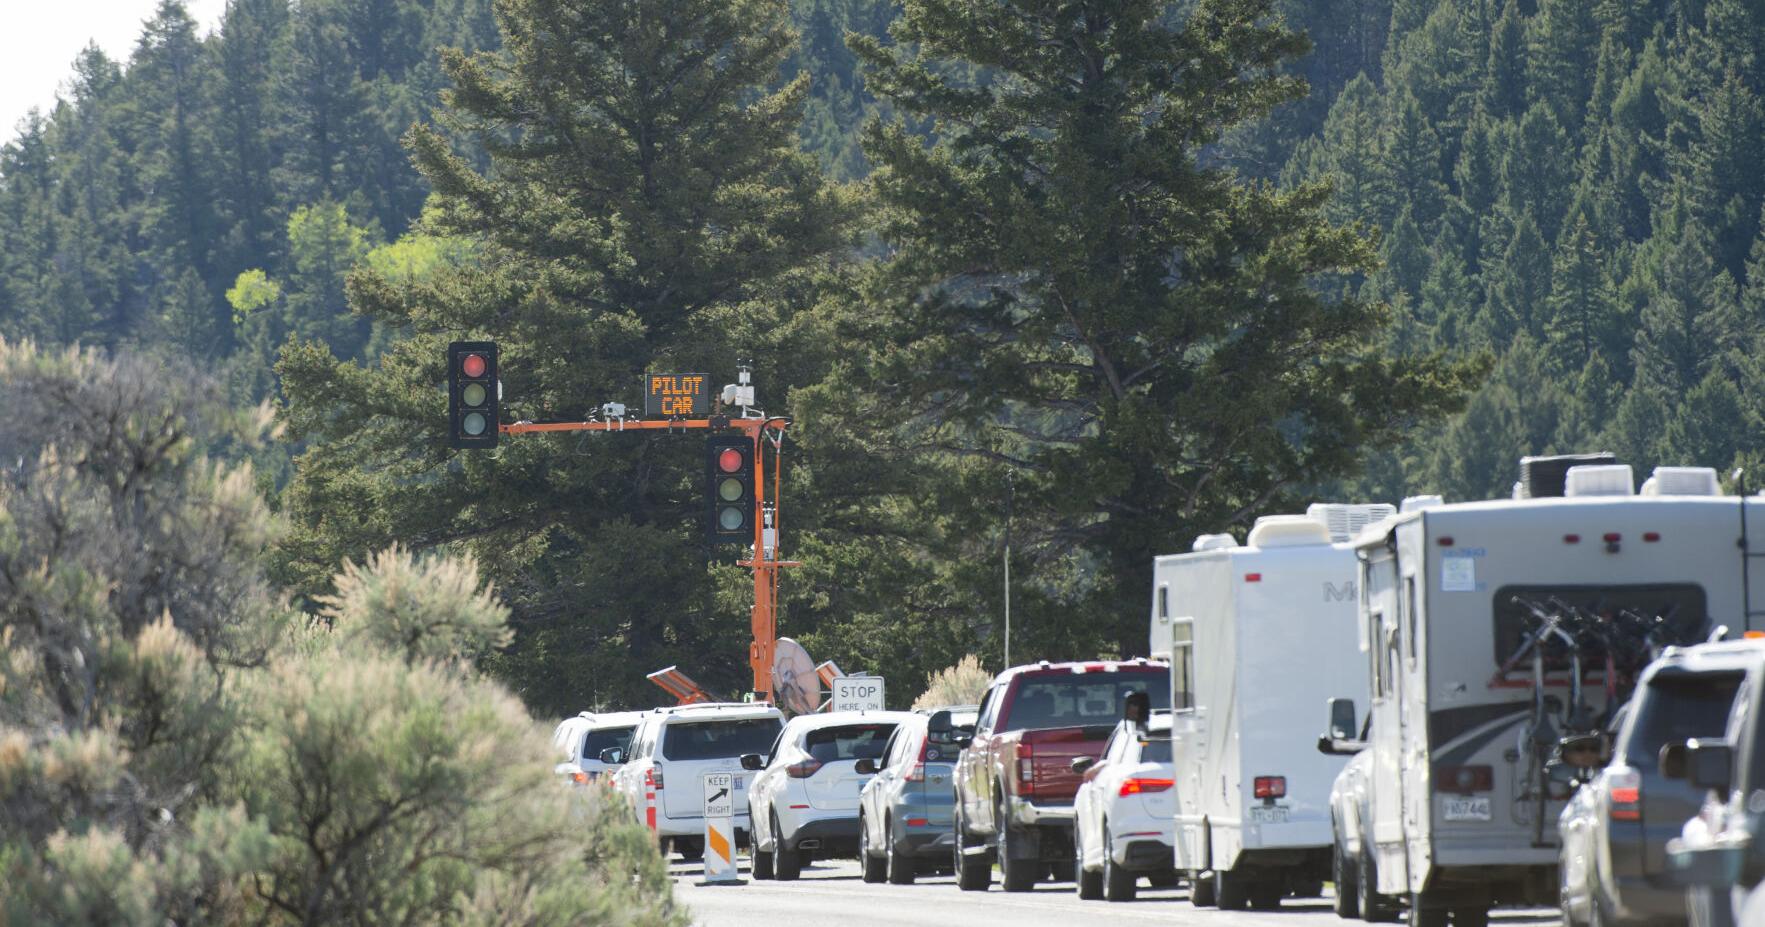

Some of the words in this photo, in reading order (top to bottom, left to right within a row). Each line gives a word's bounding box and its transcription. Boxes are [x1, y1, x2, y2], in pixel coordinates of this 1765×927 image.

[651, 376, 703, 395] PILOT
[662, 396, 693, 415] CAR
[841, 686, 876, 698] STOP
[838, 702, 860, 711] HERE
[866, 702, 879, 710] ON
[708, 776, 729, 786] KEEP
[707, 805, 730, 815] RIGHT
